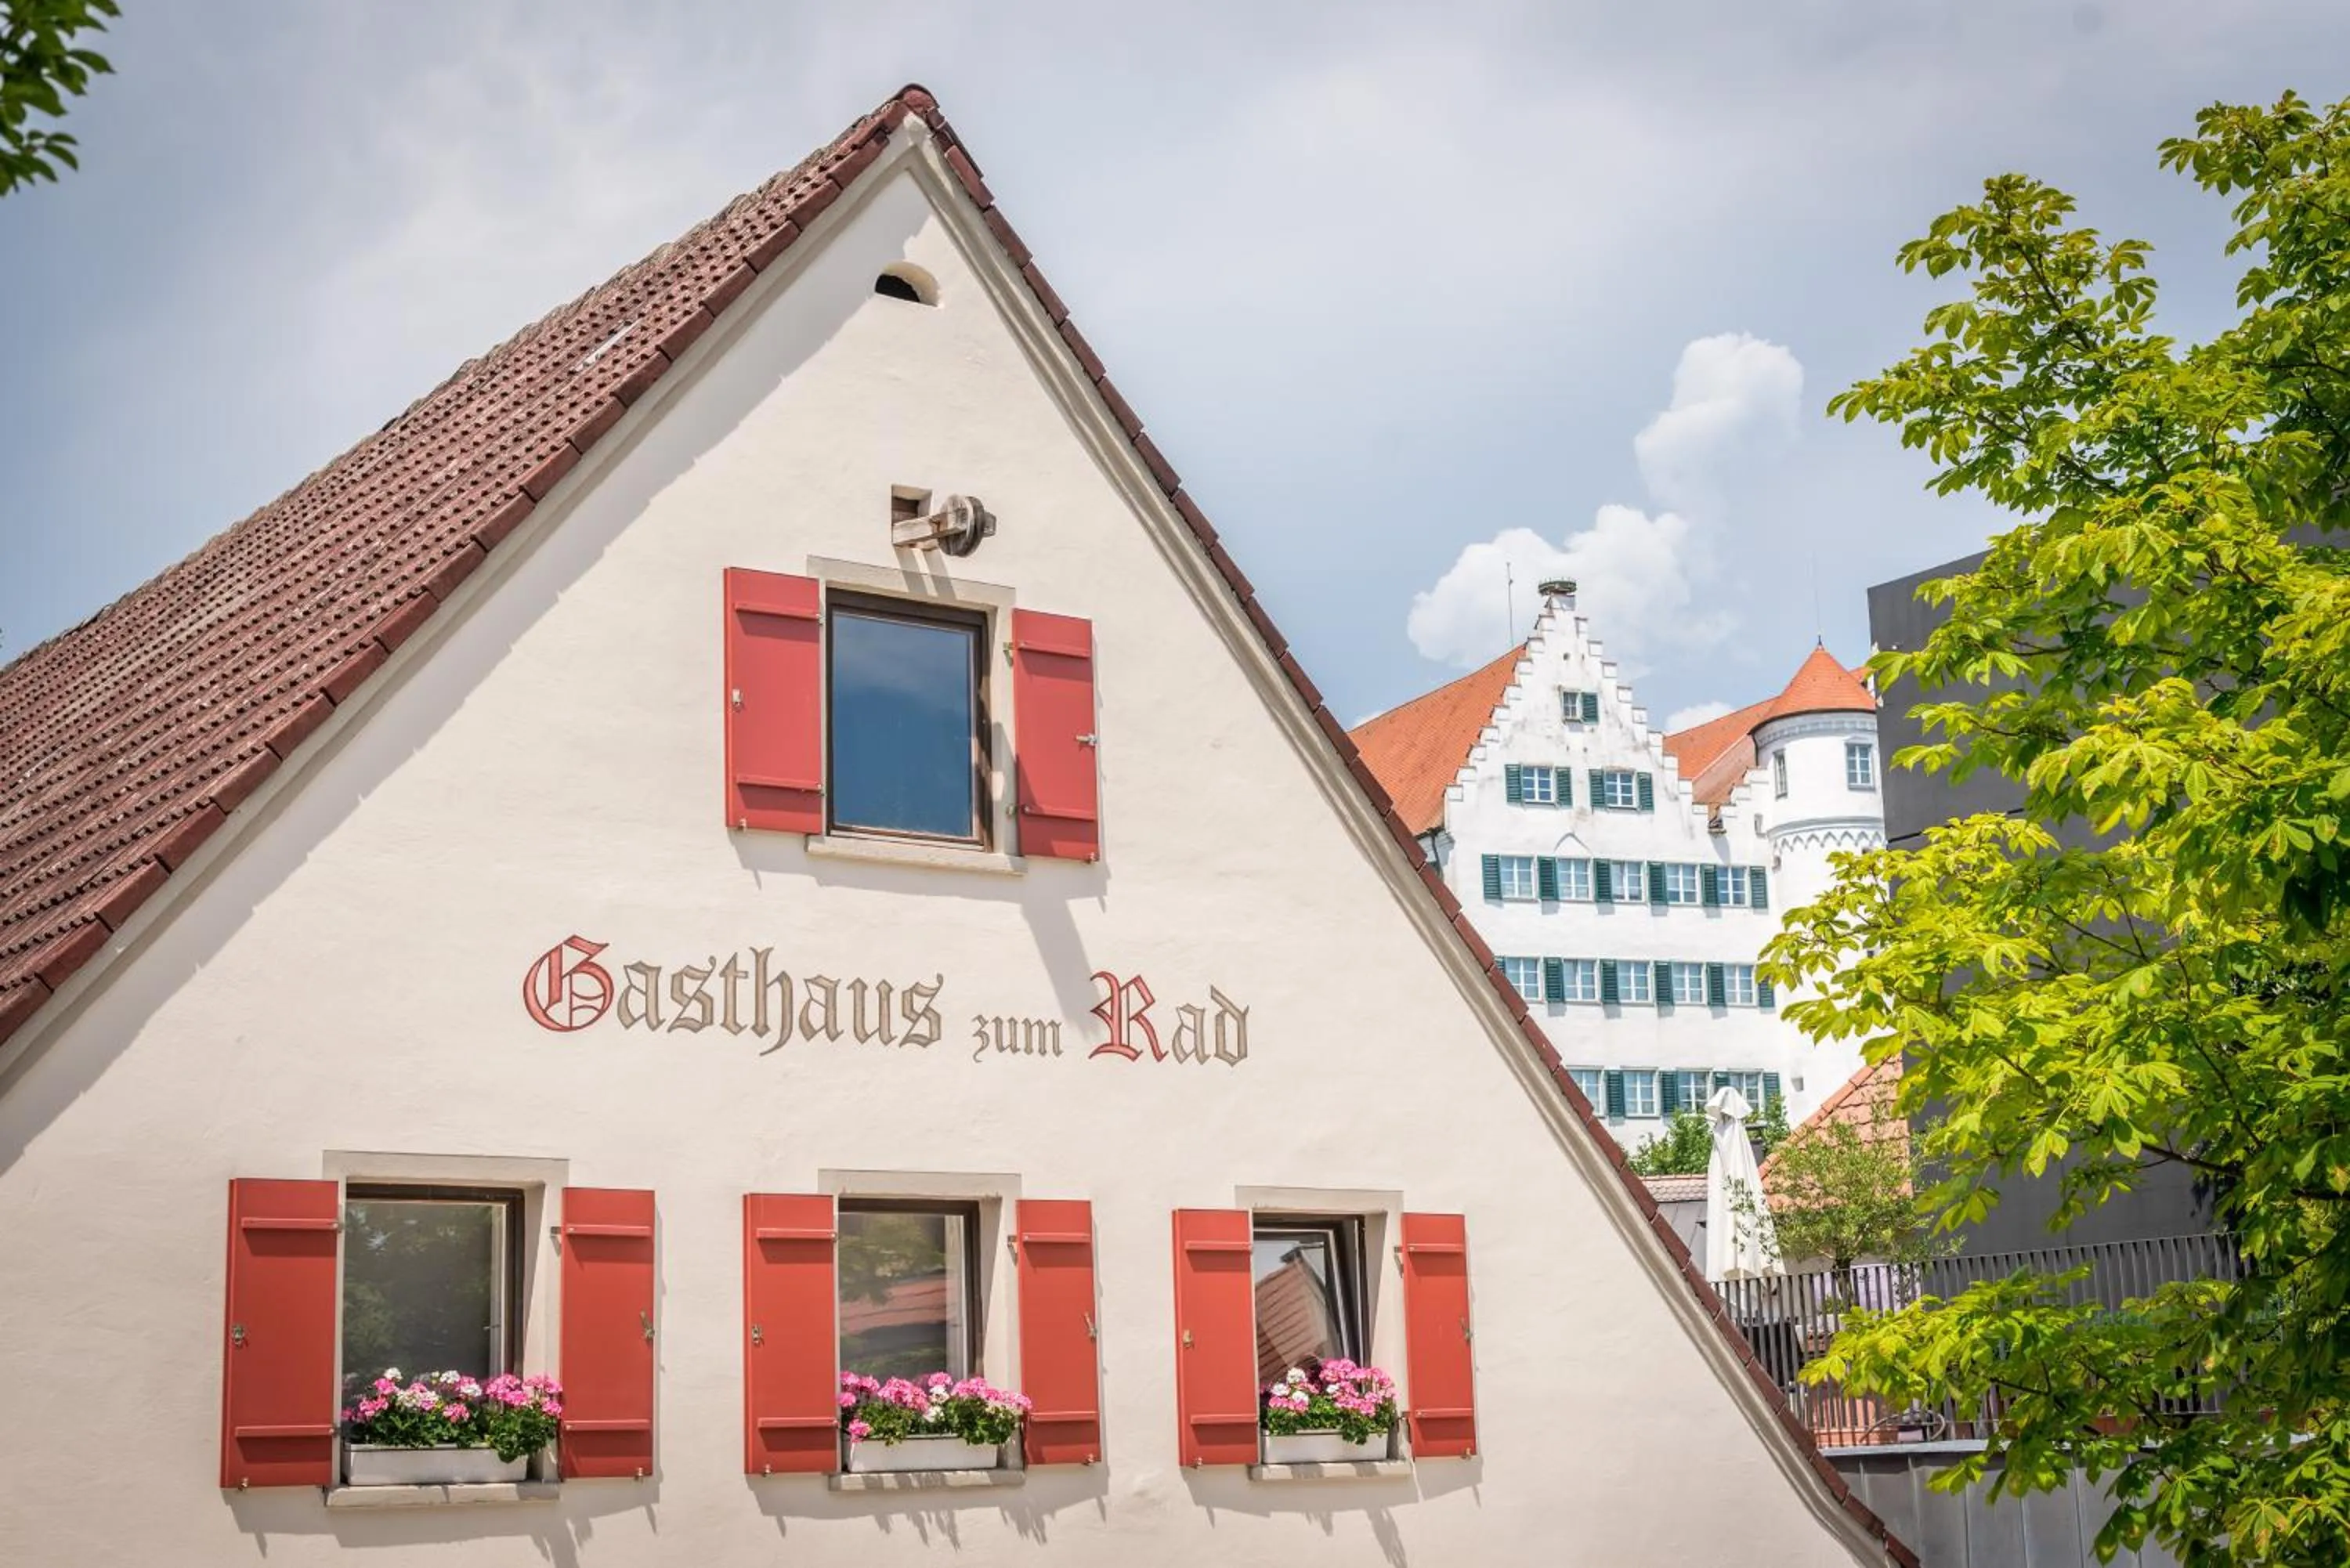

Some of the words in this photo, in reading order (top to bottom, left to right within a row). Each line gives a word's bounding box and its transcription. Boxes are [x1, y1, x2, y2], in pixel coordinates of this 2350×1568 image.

[522, 934, 944, 1057] Gasthaus
[971, 1014, 1065, 1064] zum
[1088, 970, 1250, 1068] Rad
